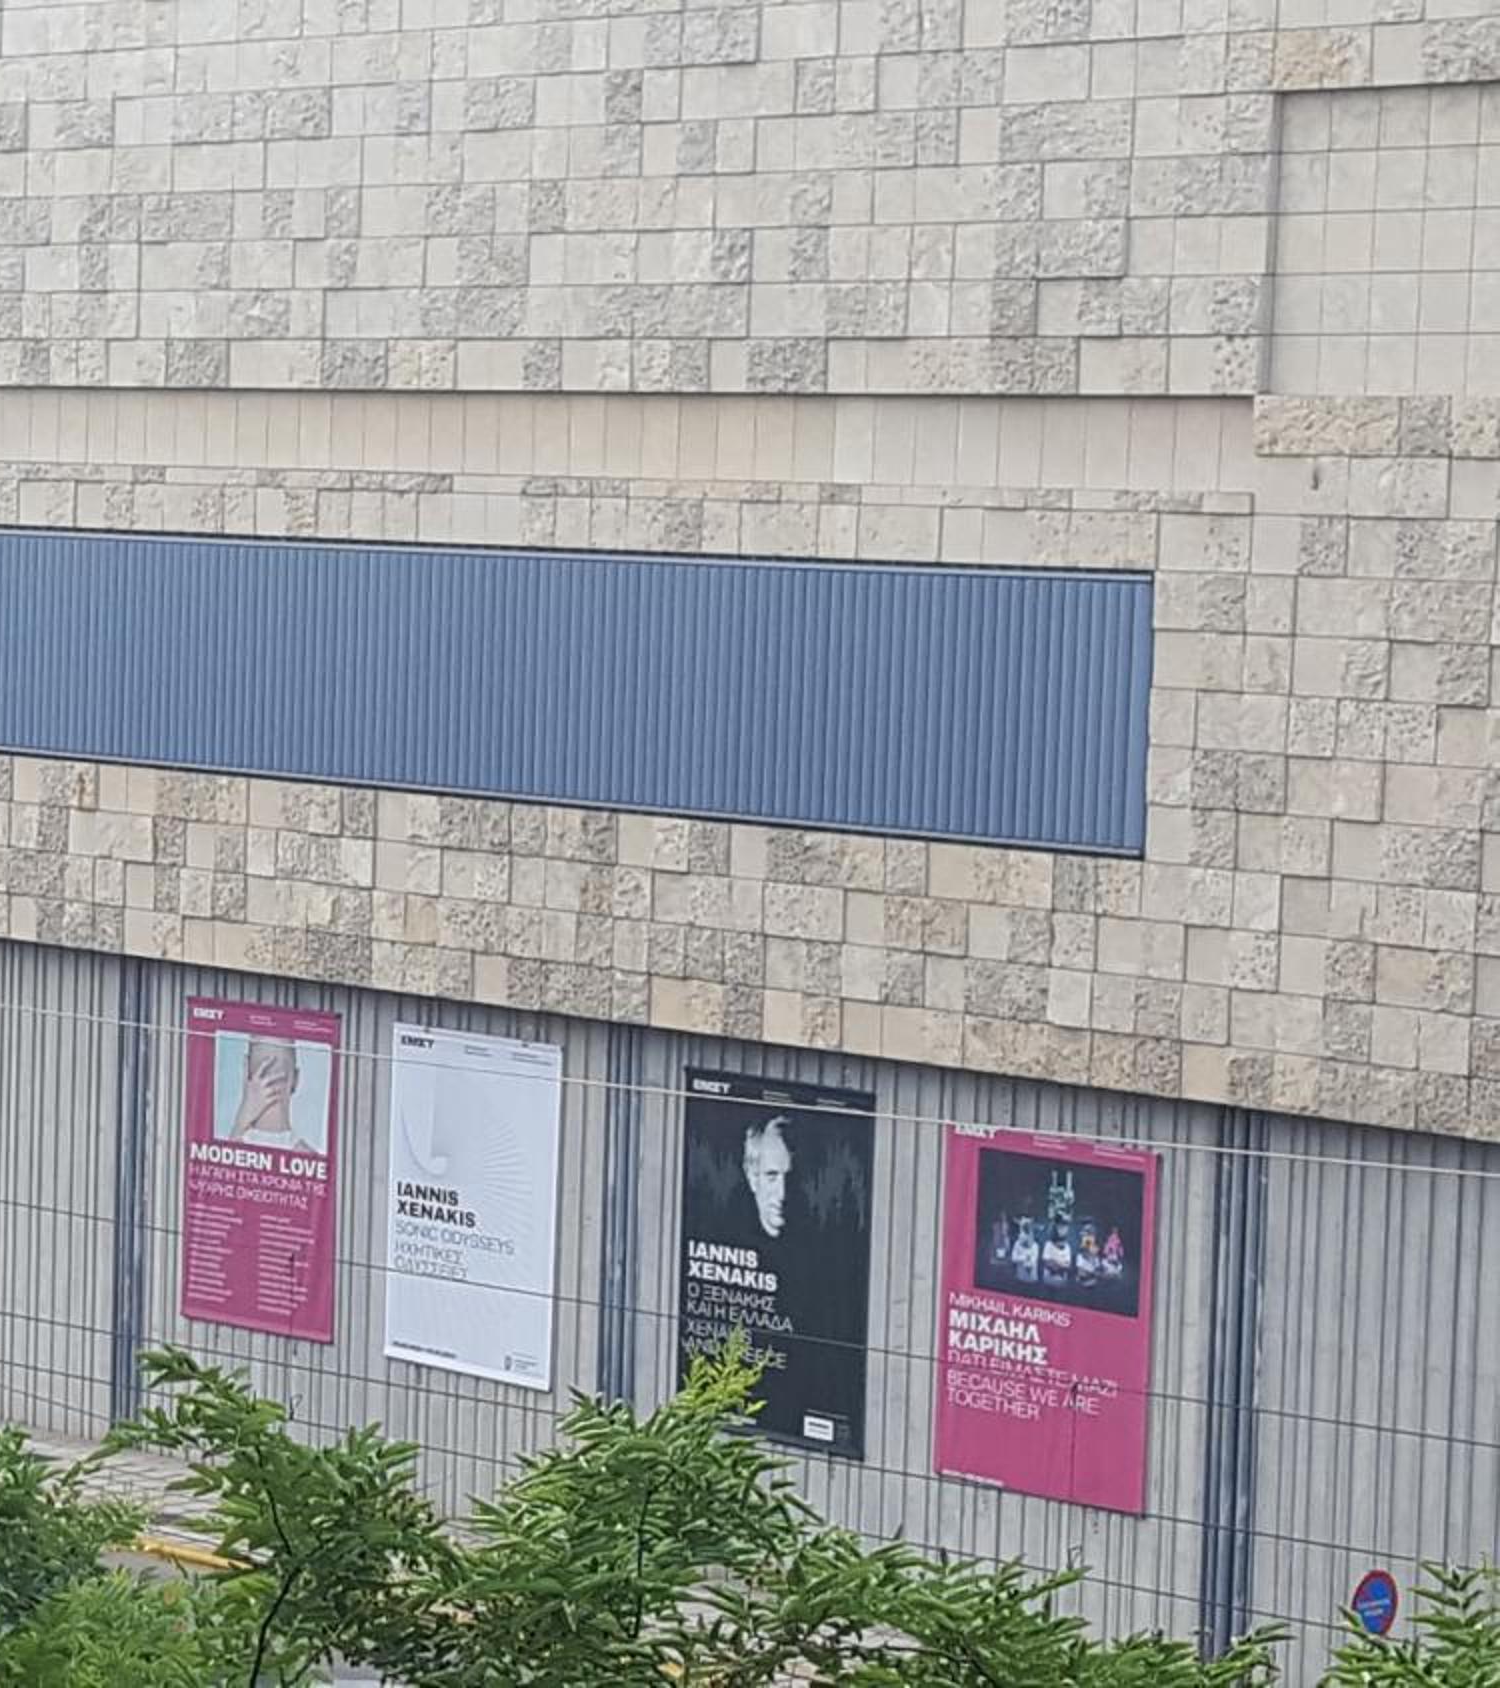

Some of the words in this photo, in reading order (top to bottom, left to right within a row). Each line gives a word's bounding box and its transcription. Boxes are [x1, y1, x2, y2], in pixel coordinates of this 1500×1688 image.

[190, 1142, 273, 1171] MODERN
[279, 1155, 328, 1180] LOVE
[397, 1181, 459, 1207] IANNIS
[397, 1200, 477, 1229] XENAKIS
[440, 1228, 516, 1256] ODYSSEYS
[688, 1239, 758, 1268] IANNIS
[687, 1259, 777, 1292] XENAKIS
[950, 1292, 1009, 1316] MIKHAIL
[1012, 1303, 1072, 1328] KARIKIS
[950, 1309, 1041, 1344] ΜΙΧΑΗΛ
[949, 1330, 1048, 1366] ΚΑΡΙΚΗΣ
[947, 1387, 1041, 1420] TOGETHER
[948, 1369, 1027, 1400] BECAUSE
[1029, 1386, 1059, 1408] WE
[1062, 1391, 1102, 1416] ARE
